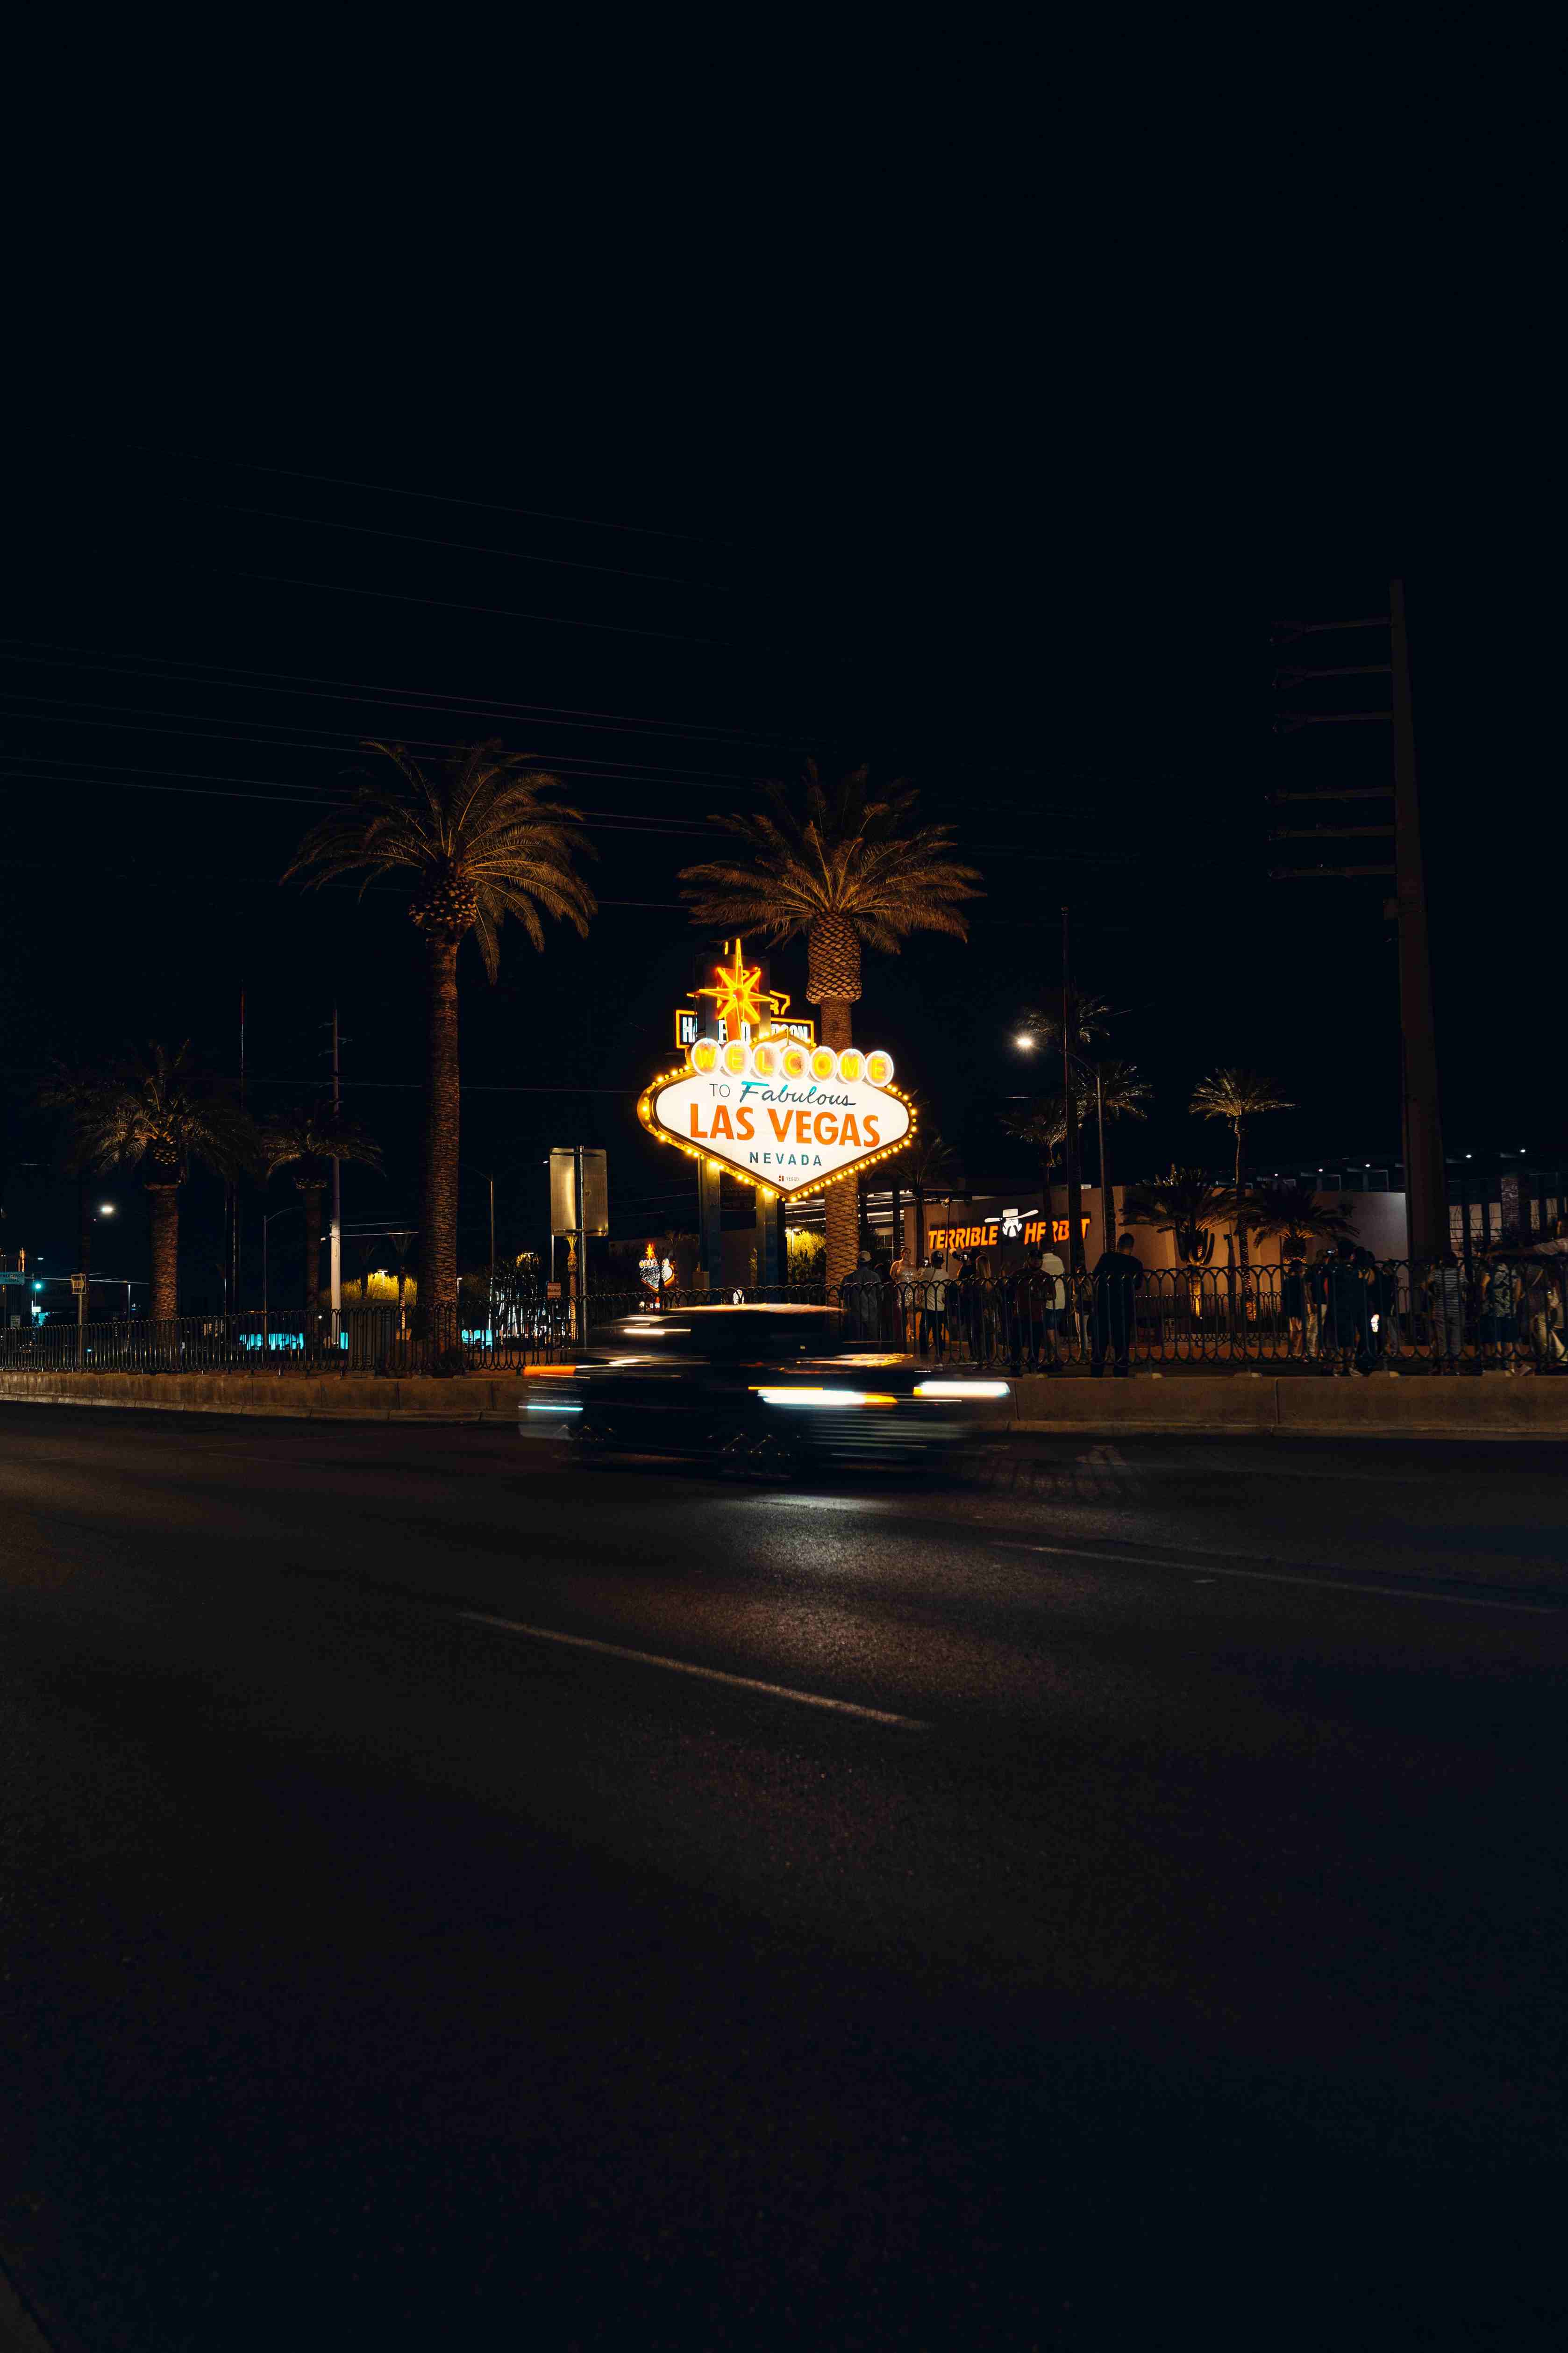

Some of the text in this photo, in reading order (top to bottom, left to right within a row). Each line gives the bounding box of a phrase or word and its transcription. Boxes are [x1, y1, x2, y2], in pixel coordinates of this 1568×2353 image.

[695, 1046, 886, 1079] WELCOME
[709, 1081, 856, 1106] TO Fabulous
[690, 1103, 880, 1147] LAS VEGAS
[749, 1151, 822, 1166] NEVADA
[928, 1218, 1090, 1250] TERRIBLE HERBT
